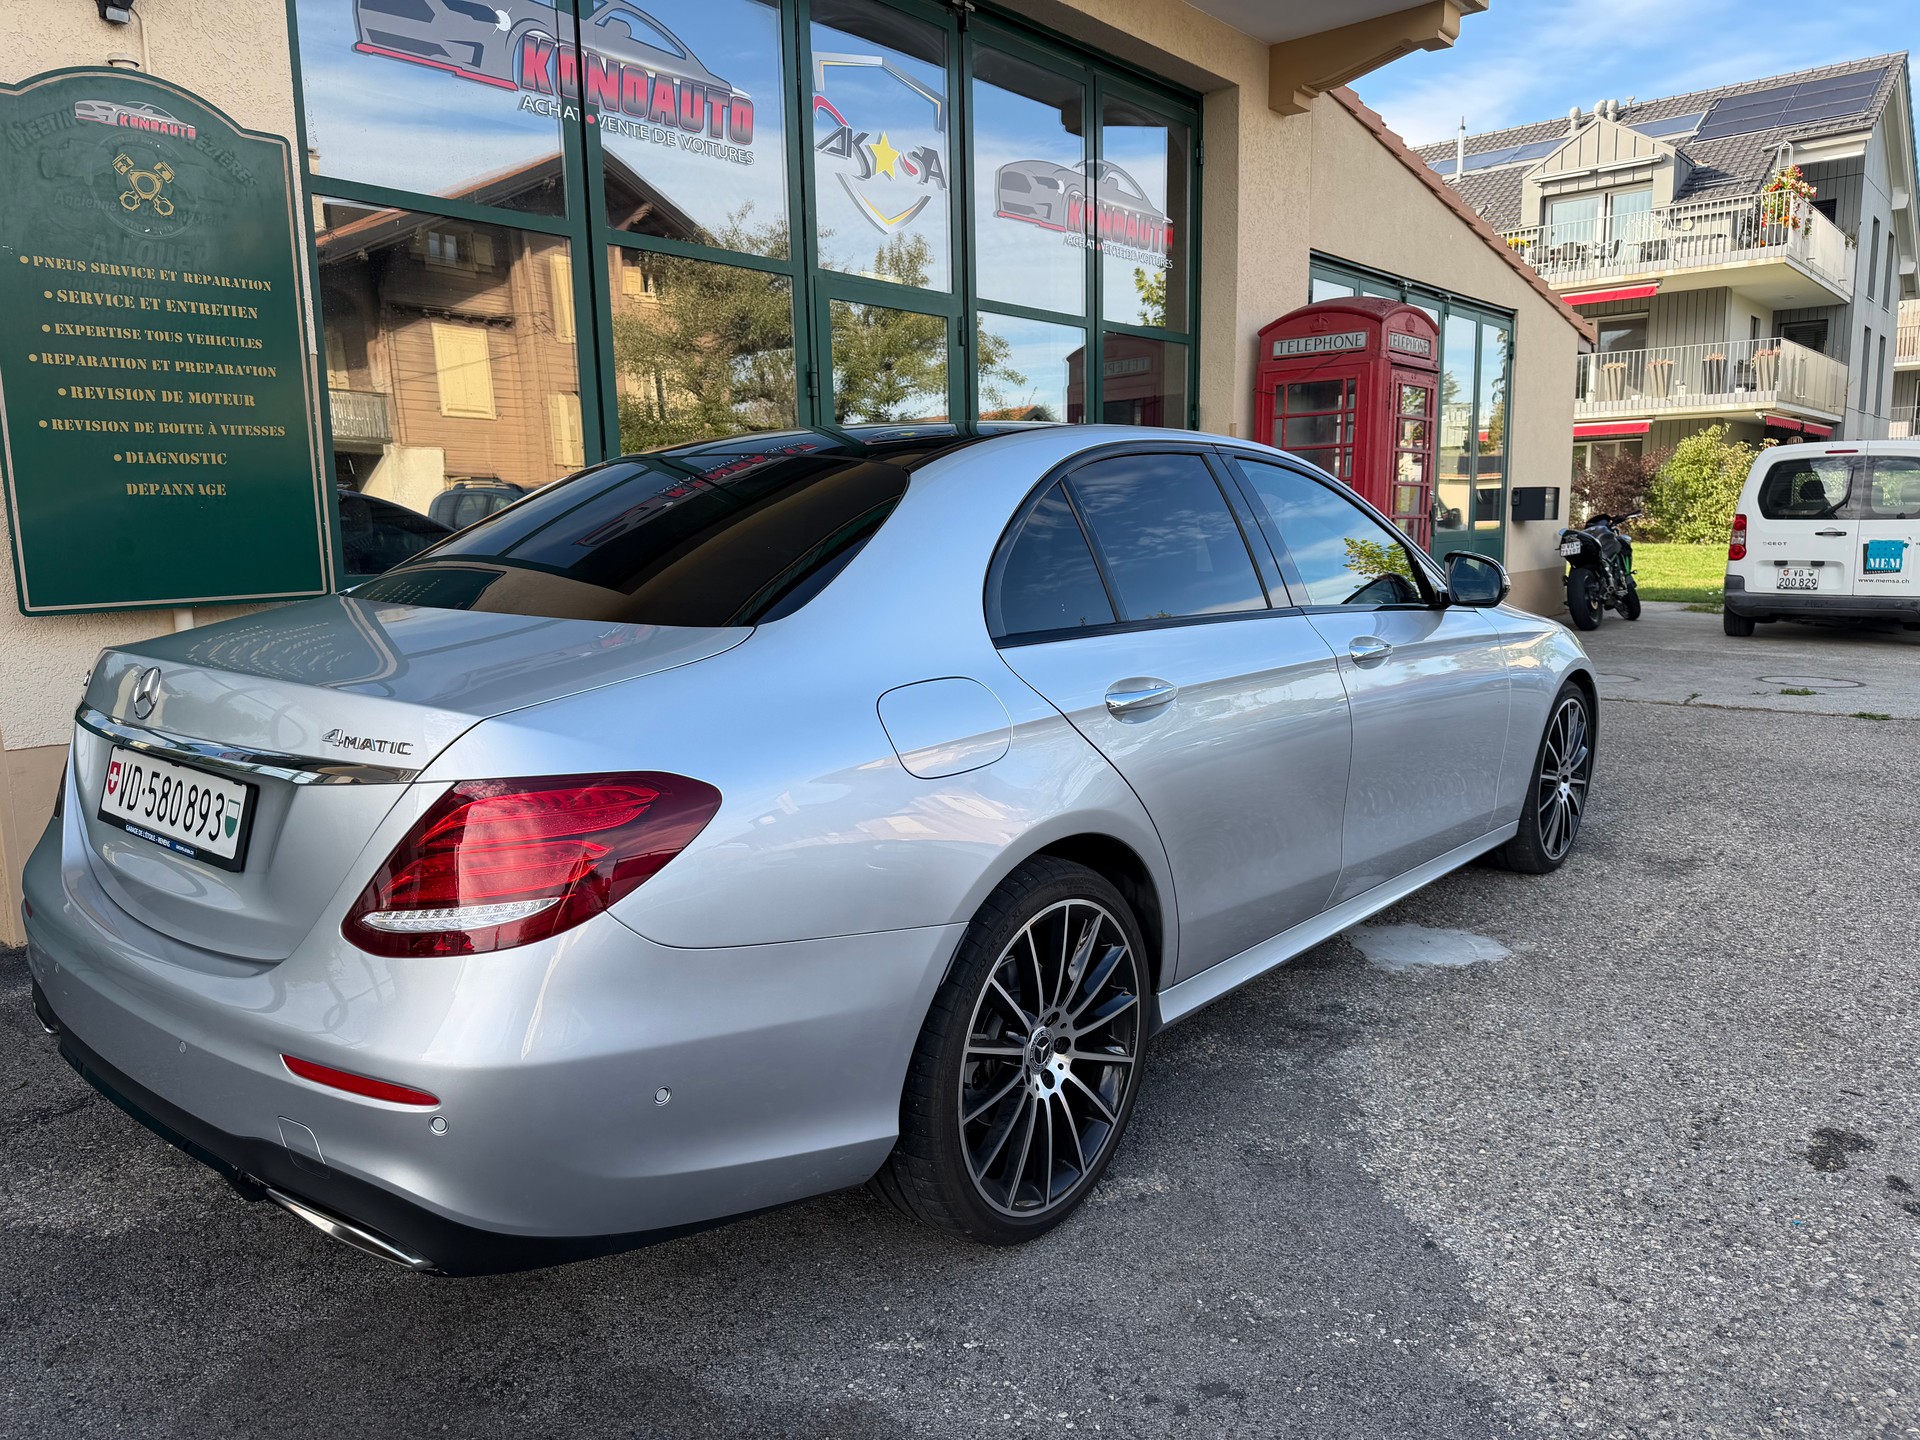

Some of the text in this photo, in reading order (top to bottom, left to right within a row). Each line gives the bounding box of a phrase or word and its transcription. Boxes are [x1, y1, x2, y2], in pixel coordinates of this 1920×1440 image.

[522, 35, 754, 145] KONOAUTO
[120, 112, 196, 139] KONOAUTO
[522, 95, 754, 165] ACHAT VENTE DE VOITURES
[1067, 195, 1174, 255] KONOAUTO
[1066, 236, 1095, 250] ACHAT
[33, 255, 87, 272] PNEUS
[90, 261, 156, 280] SERVICE
[160, 269, 178, 282] ET
[183, 272, 272, 292] REPARATION
[57, 289, 258, 320] SERVICE ET ENTRETIEN
[54, 323, 263, 349] EXPERTISE TOUS VEHICULES
[1278, 333, 1364, 354] TELEPHONE
[1389, 333, 1429, 354] TELEPHONE
[41, 352, 277, 378] REPARATION ET PREPARATION
[70, 385, 256, 407] REVISION DE MOTEUR
[51, 418, 286, 437] REVISION DE BOITE À VITESSES
[125, 451, 227, 466] DIAGNOSTIC
[126, 483, 227, 497] DEPANNAGE
[1794, 569, 1804, 577] VD
[1869, 558, 1901, 569] MEM
[321, 728, 414, 755] 4MATIC
